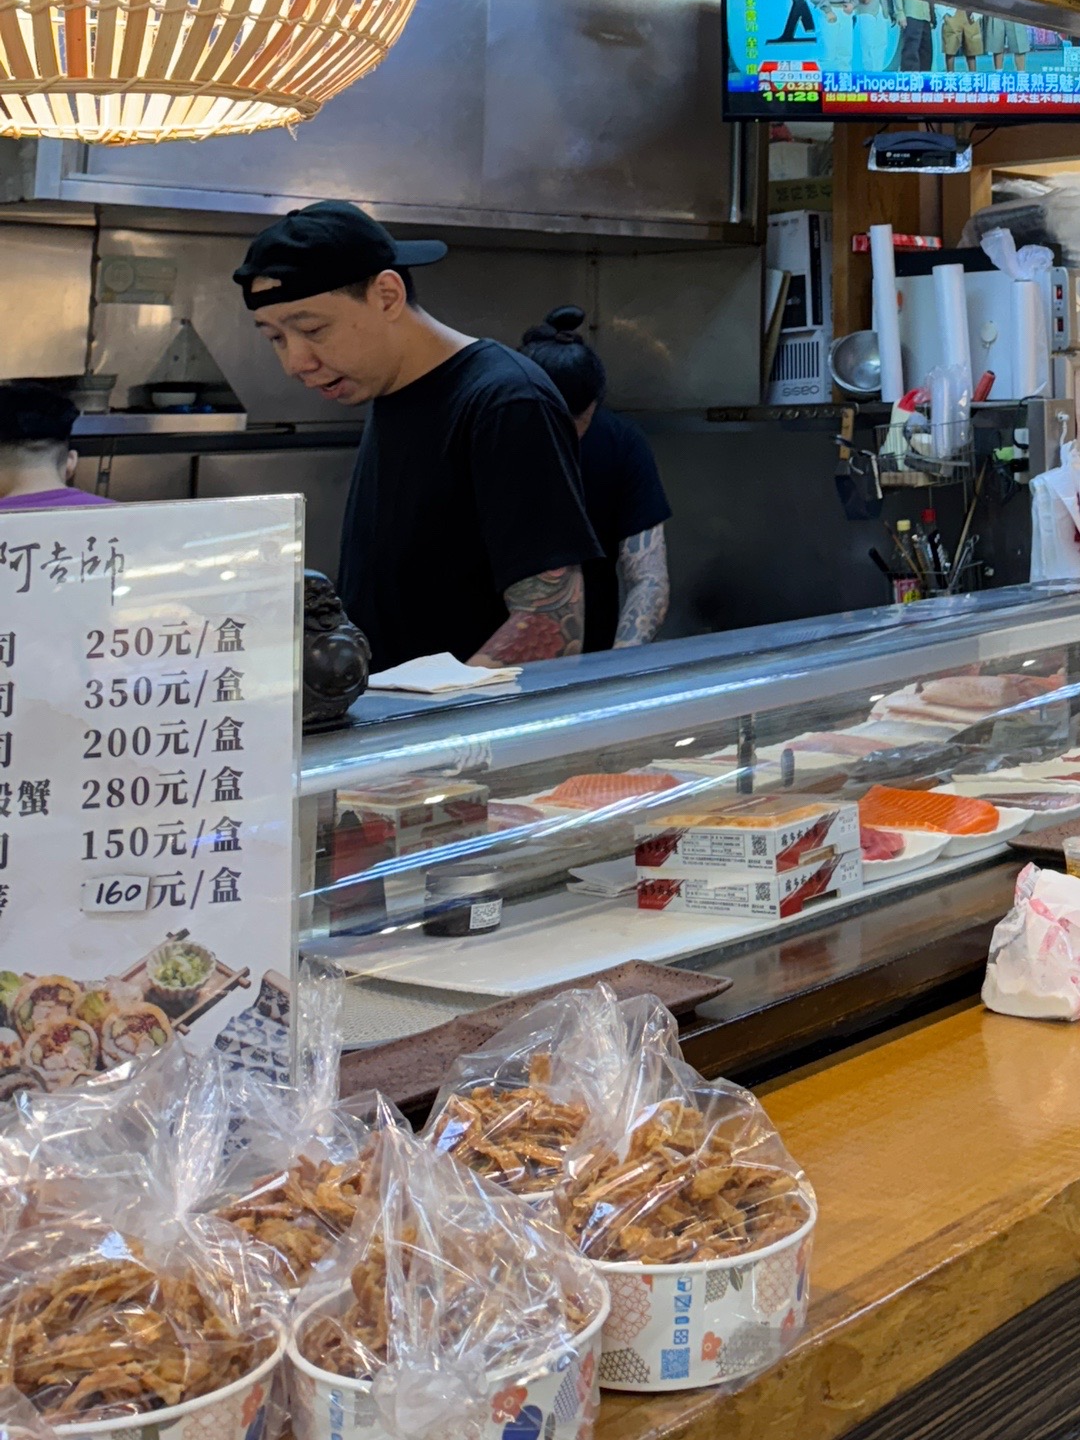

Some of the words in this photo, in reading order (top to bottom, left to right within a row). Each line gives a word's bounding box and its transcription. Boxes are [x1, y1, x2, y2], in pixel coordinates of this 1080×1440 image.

[762, 91, 819, 102] 11:28
[86, 617, 246, 659] 250元/盒
[84, 666, 245, 709] 350元/盒
[83, 715, 244, 759] 200元/盒
[81, 765, 244, 809] 280元/盒
[81, 815, 243, 861] 150元/盒
